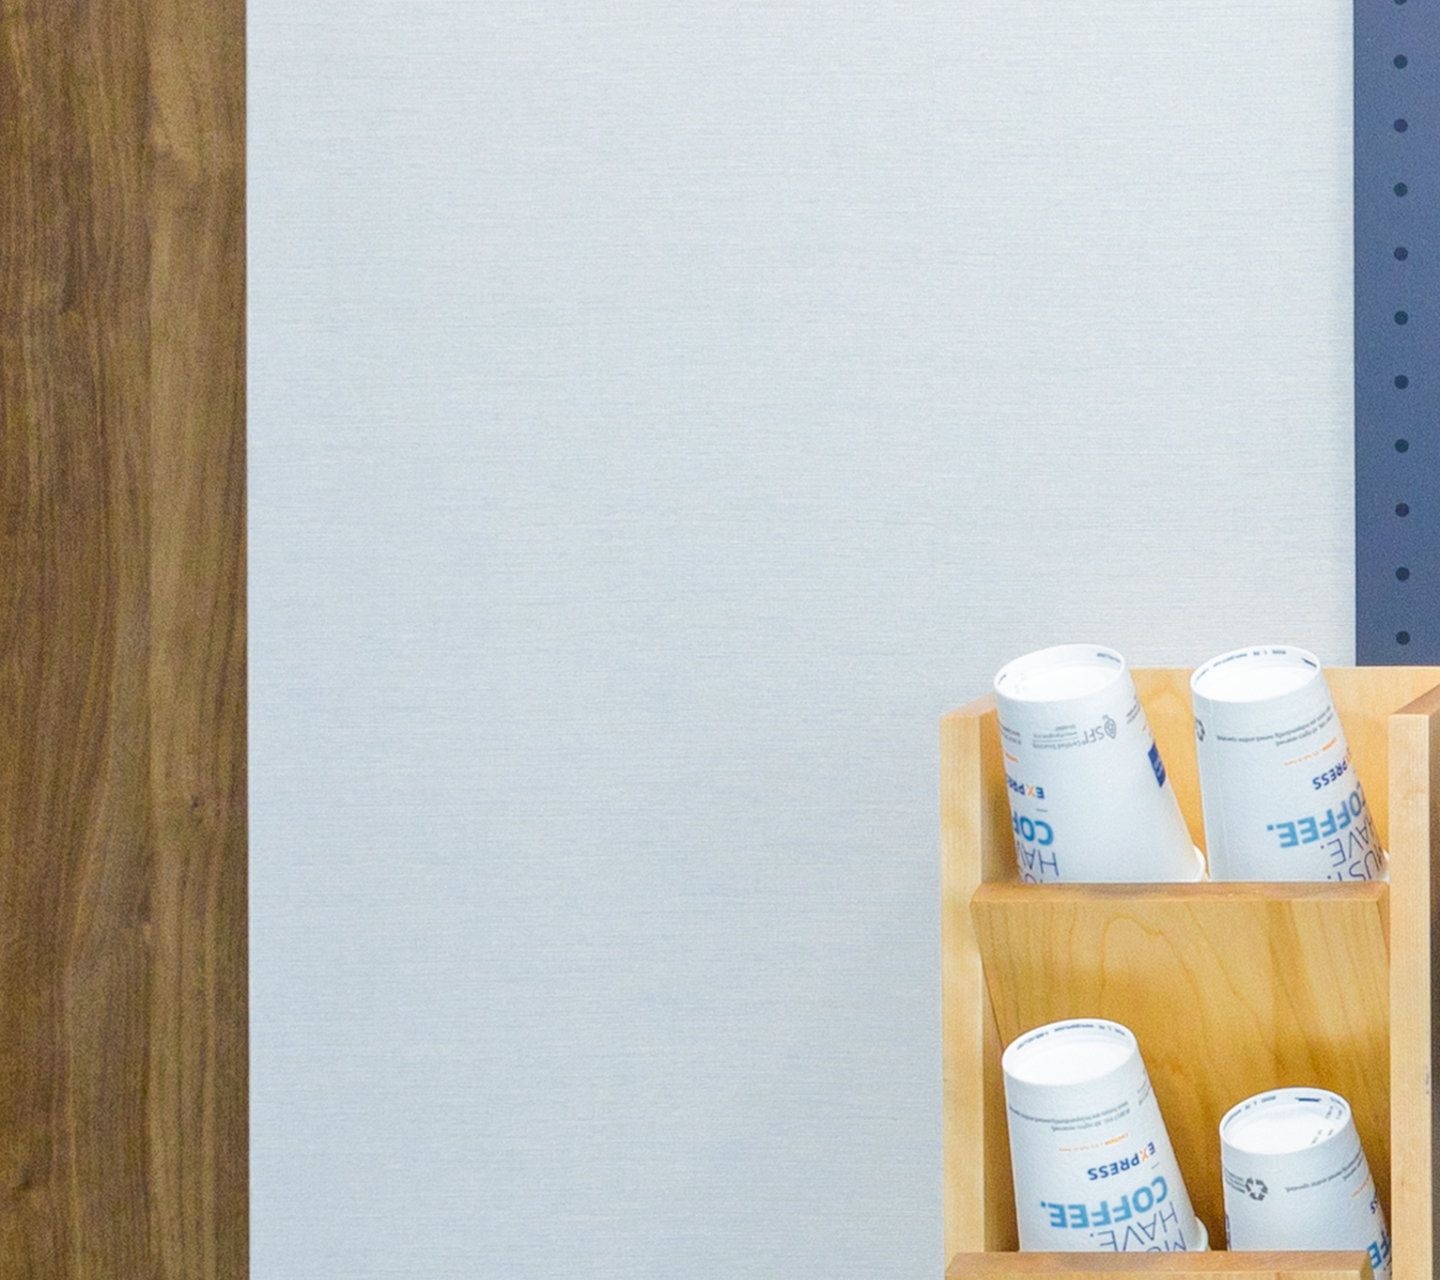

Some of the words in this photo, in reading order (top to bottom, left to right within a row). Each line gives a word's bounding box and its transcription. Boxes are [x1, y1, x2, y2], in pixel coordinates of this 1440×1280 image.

[1087, 1142, 1156, 1181] EXPRESS
[1041, 1176, 1168, 1229] COFFEE.
[1090, 1201, 1178, 1252] HAVE.
